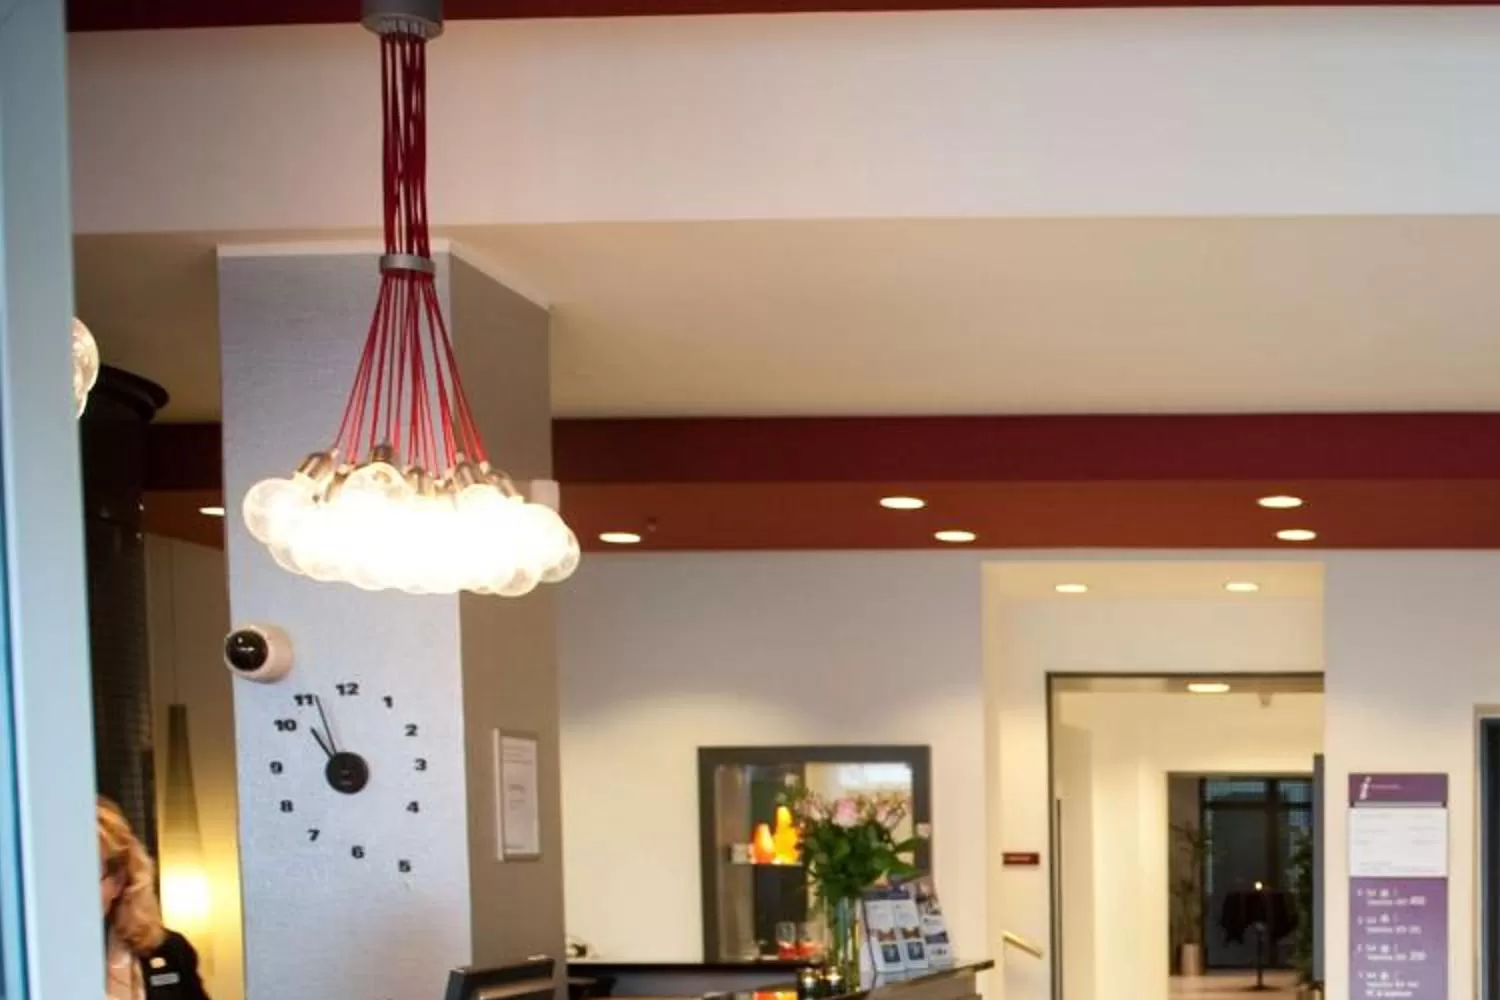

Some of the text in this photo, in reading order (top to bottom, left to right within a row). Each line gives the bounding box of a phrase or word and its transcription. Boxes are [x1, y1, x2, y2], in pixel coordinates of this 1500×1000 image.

[336, 683, 359, 696] 12
[294, 695, 314, 706] 11
[382, 696, 393, 708] 1
[274, 719, 296, 731] 10
[405, 725, 418, 736] 2
[270, 762, 283, 774] 9
[415, 760, 427, 771] 3
[280, 800, 293, 812] 8
[407, 801, 419, 813] 4
[308, 829, 320, 841] 7
[351, 846, 364, 859] 6
[399, 861, 411, 873] 5
